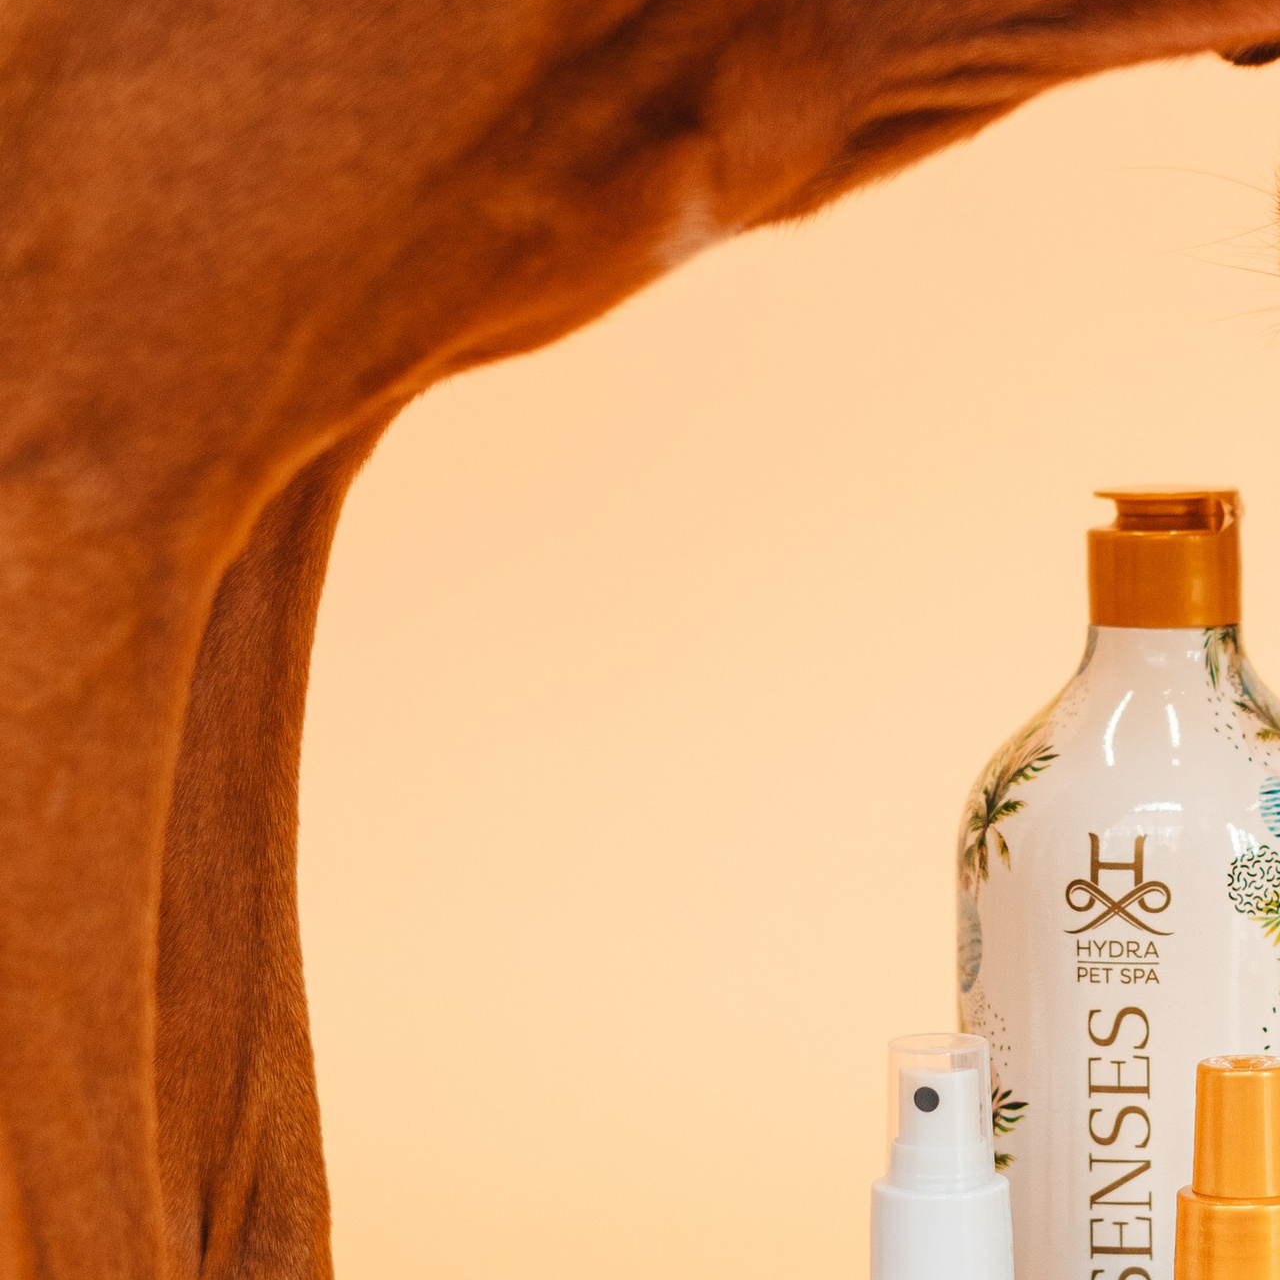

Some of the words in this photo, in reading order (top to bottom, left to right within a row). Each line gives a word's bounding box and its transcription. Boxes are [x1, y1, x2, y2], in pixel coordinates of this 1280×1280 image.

[1076, 939, 1160, 959] HYDRA
[1077, 966, 1114, 983] PET
[1120, 968, 1160, 985] SPA
